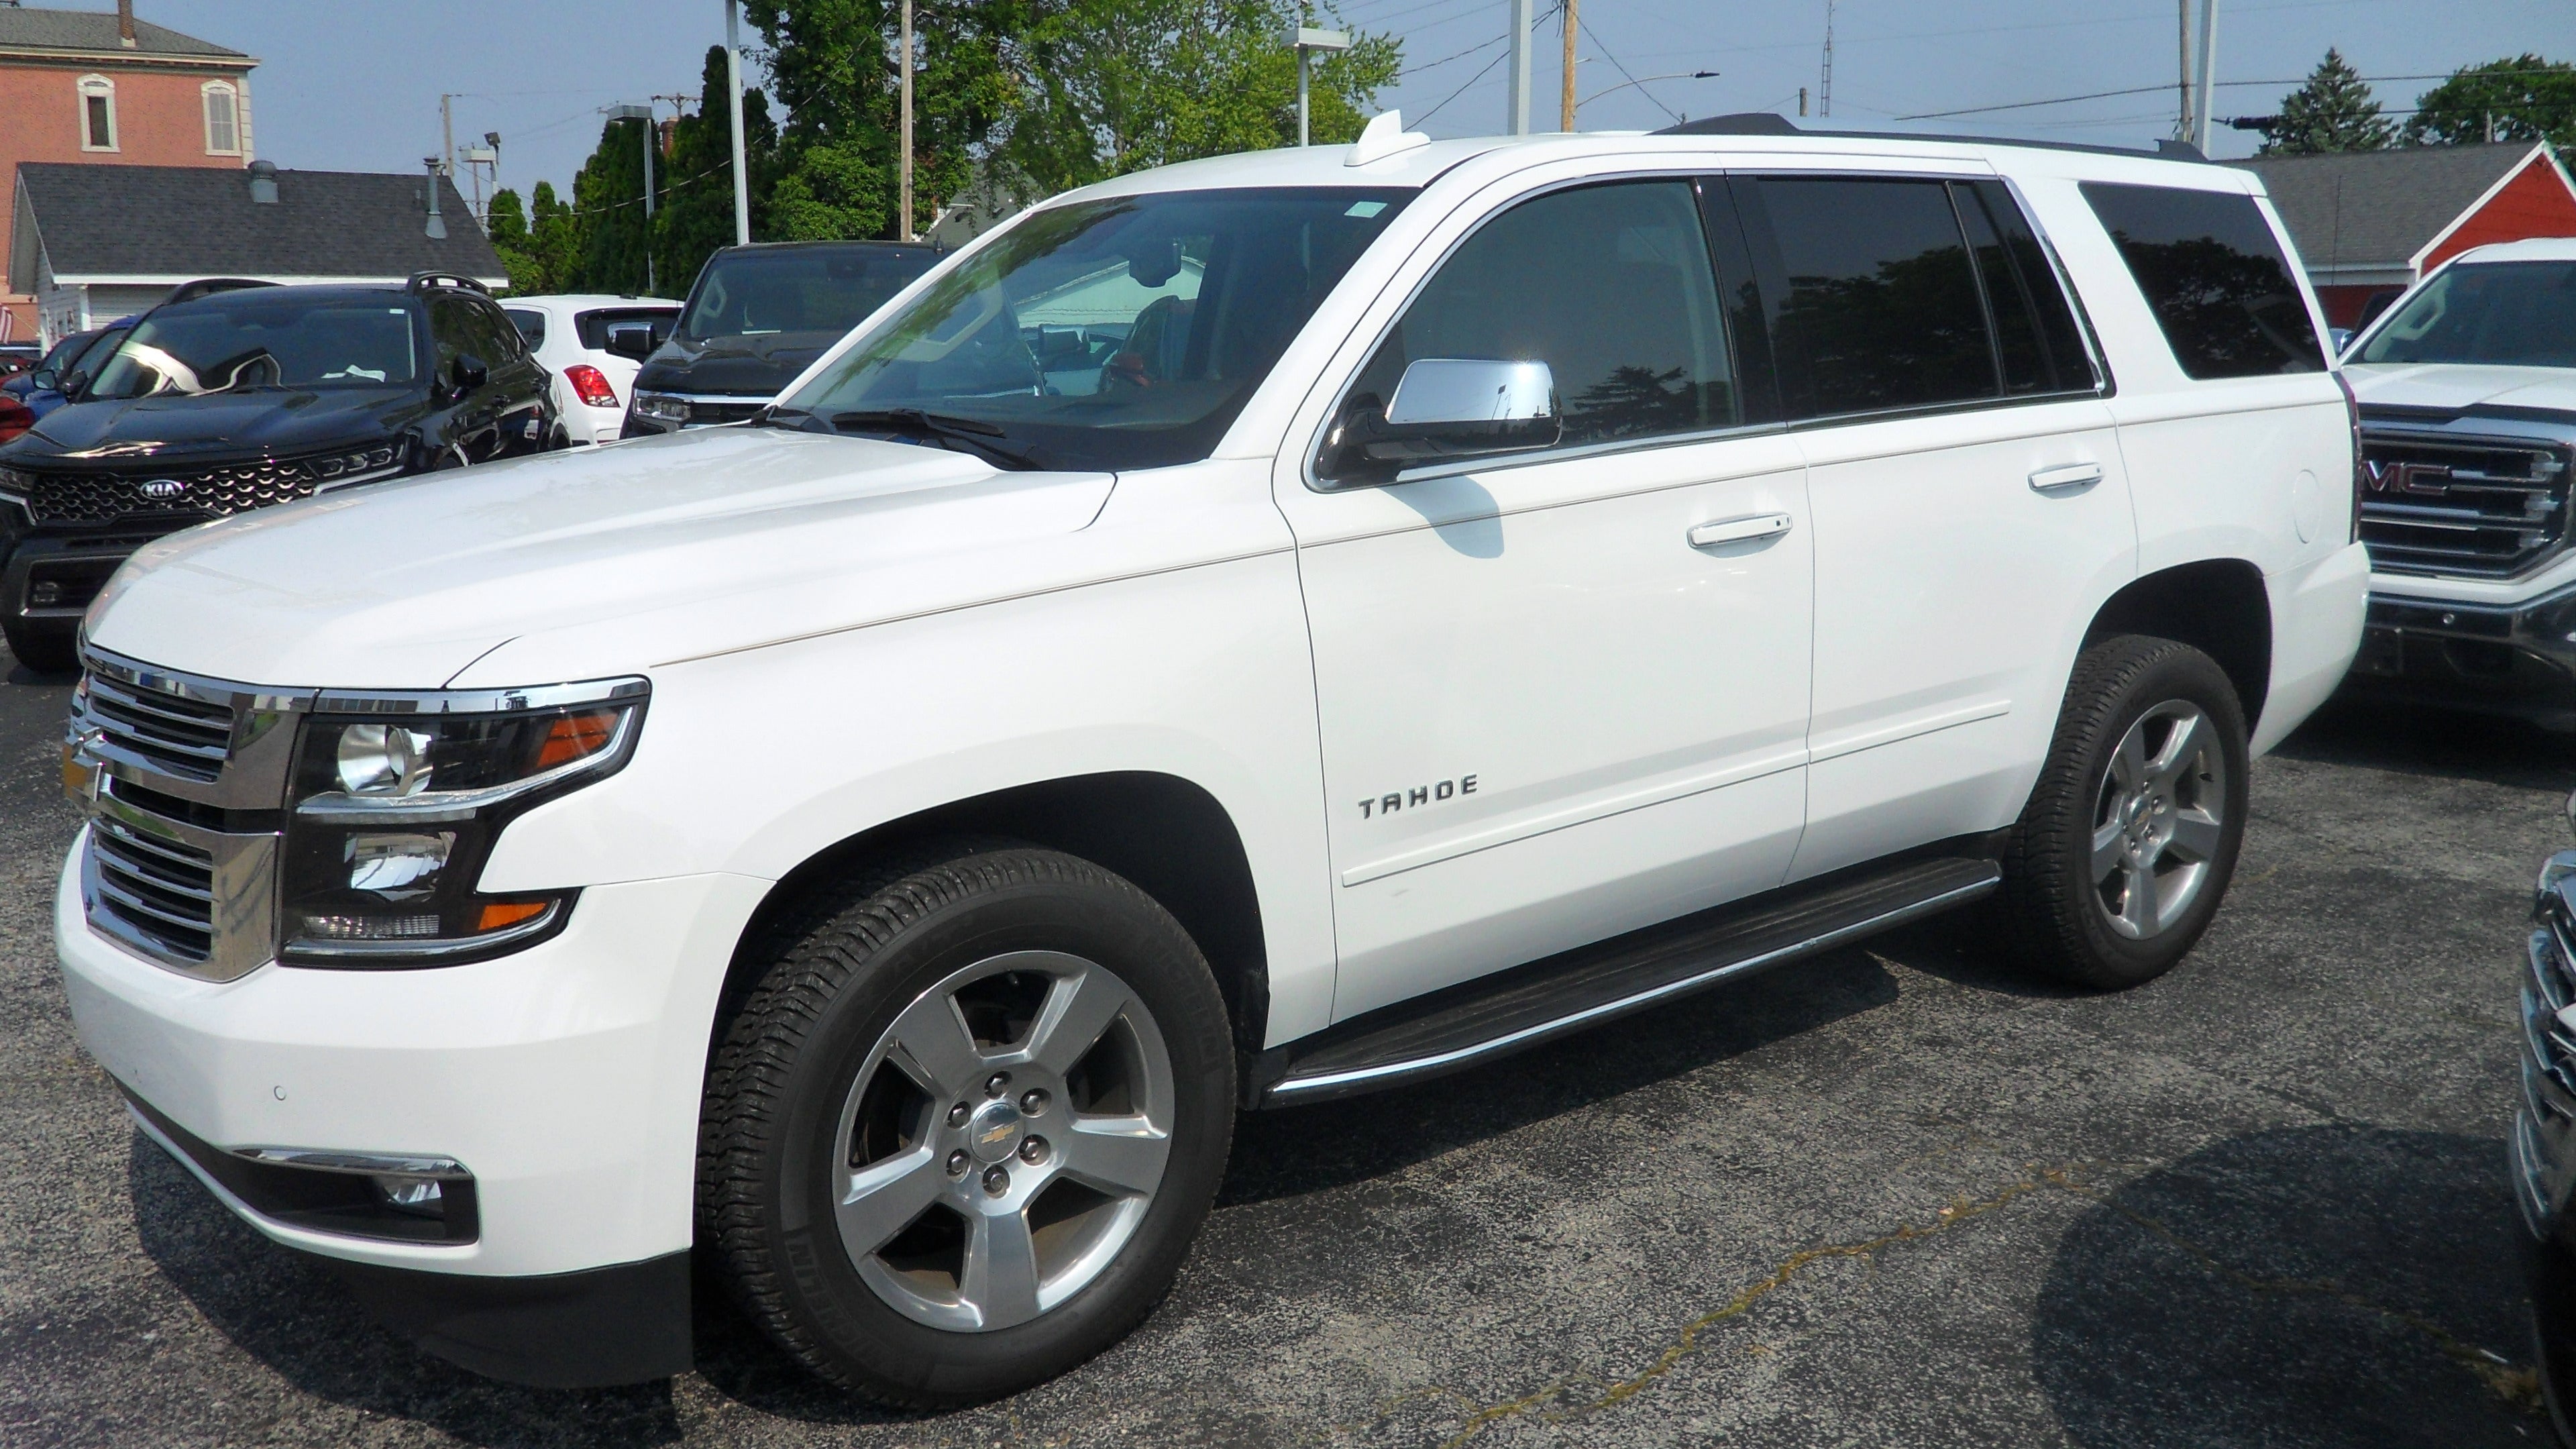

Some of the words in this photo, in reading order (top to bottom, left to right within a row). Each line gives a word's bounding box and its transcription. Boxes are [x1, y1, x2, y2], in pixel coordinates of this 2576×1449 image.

[146, 484, 176, 496] KIA
[2361, 460, 2449, 496] MC
[1358, 773, 1477, 820] TAHOE
